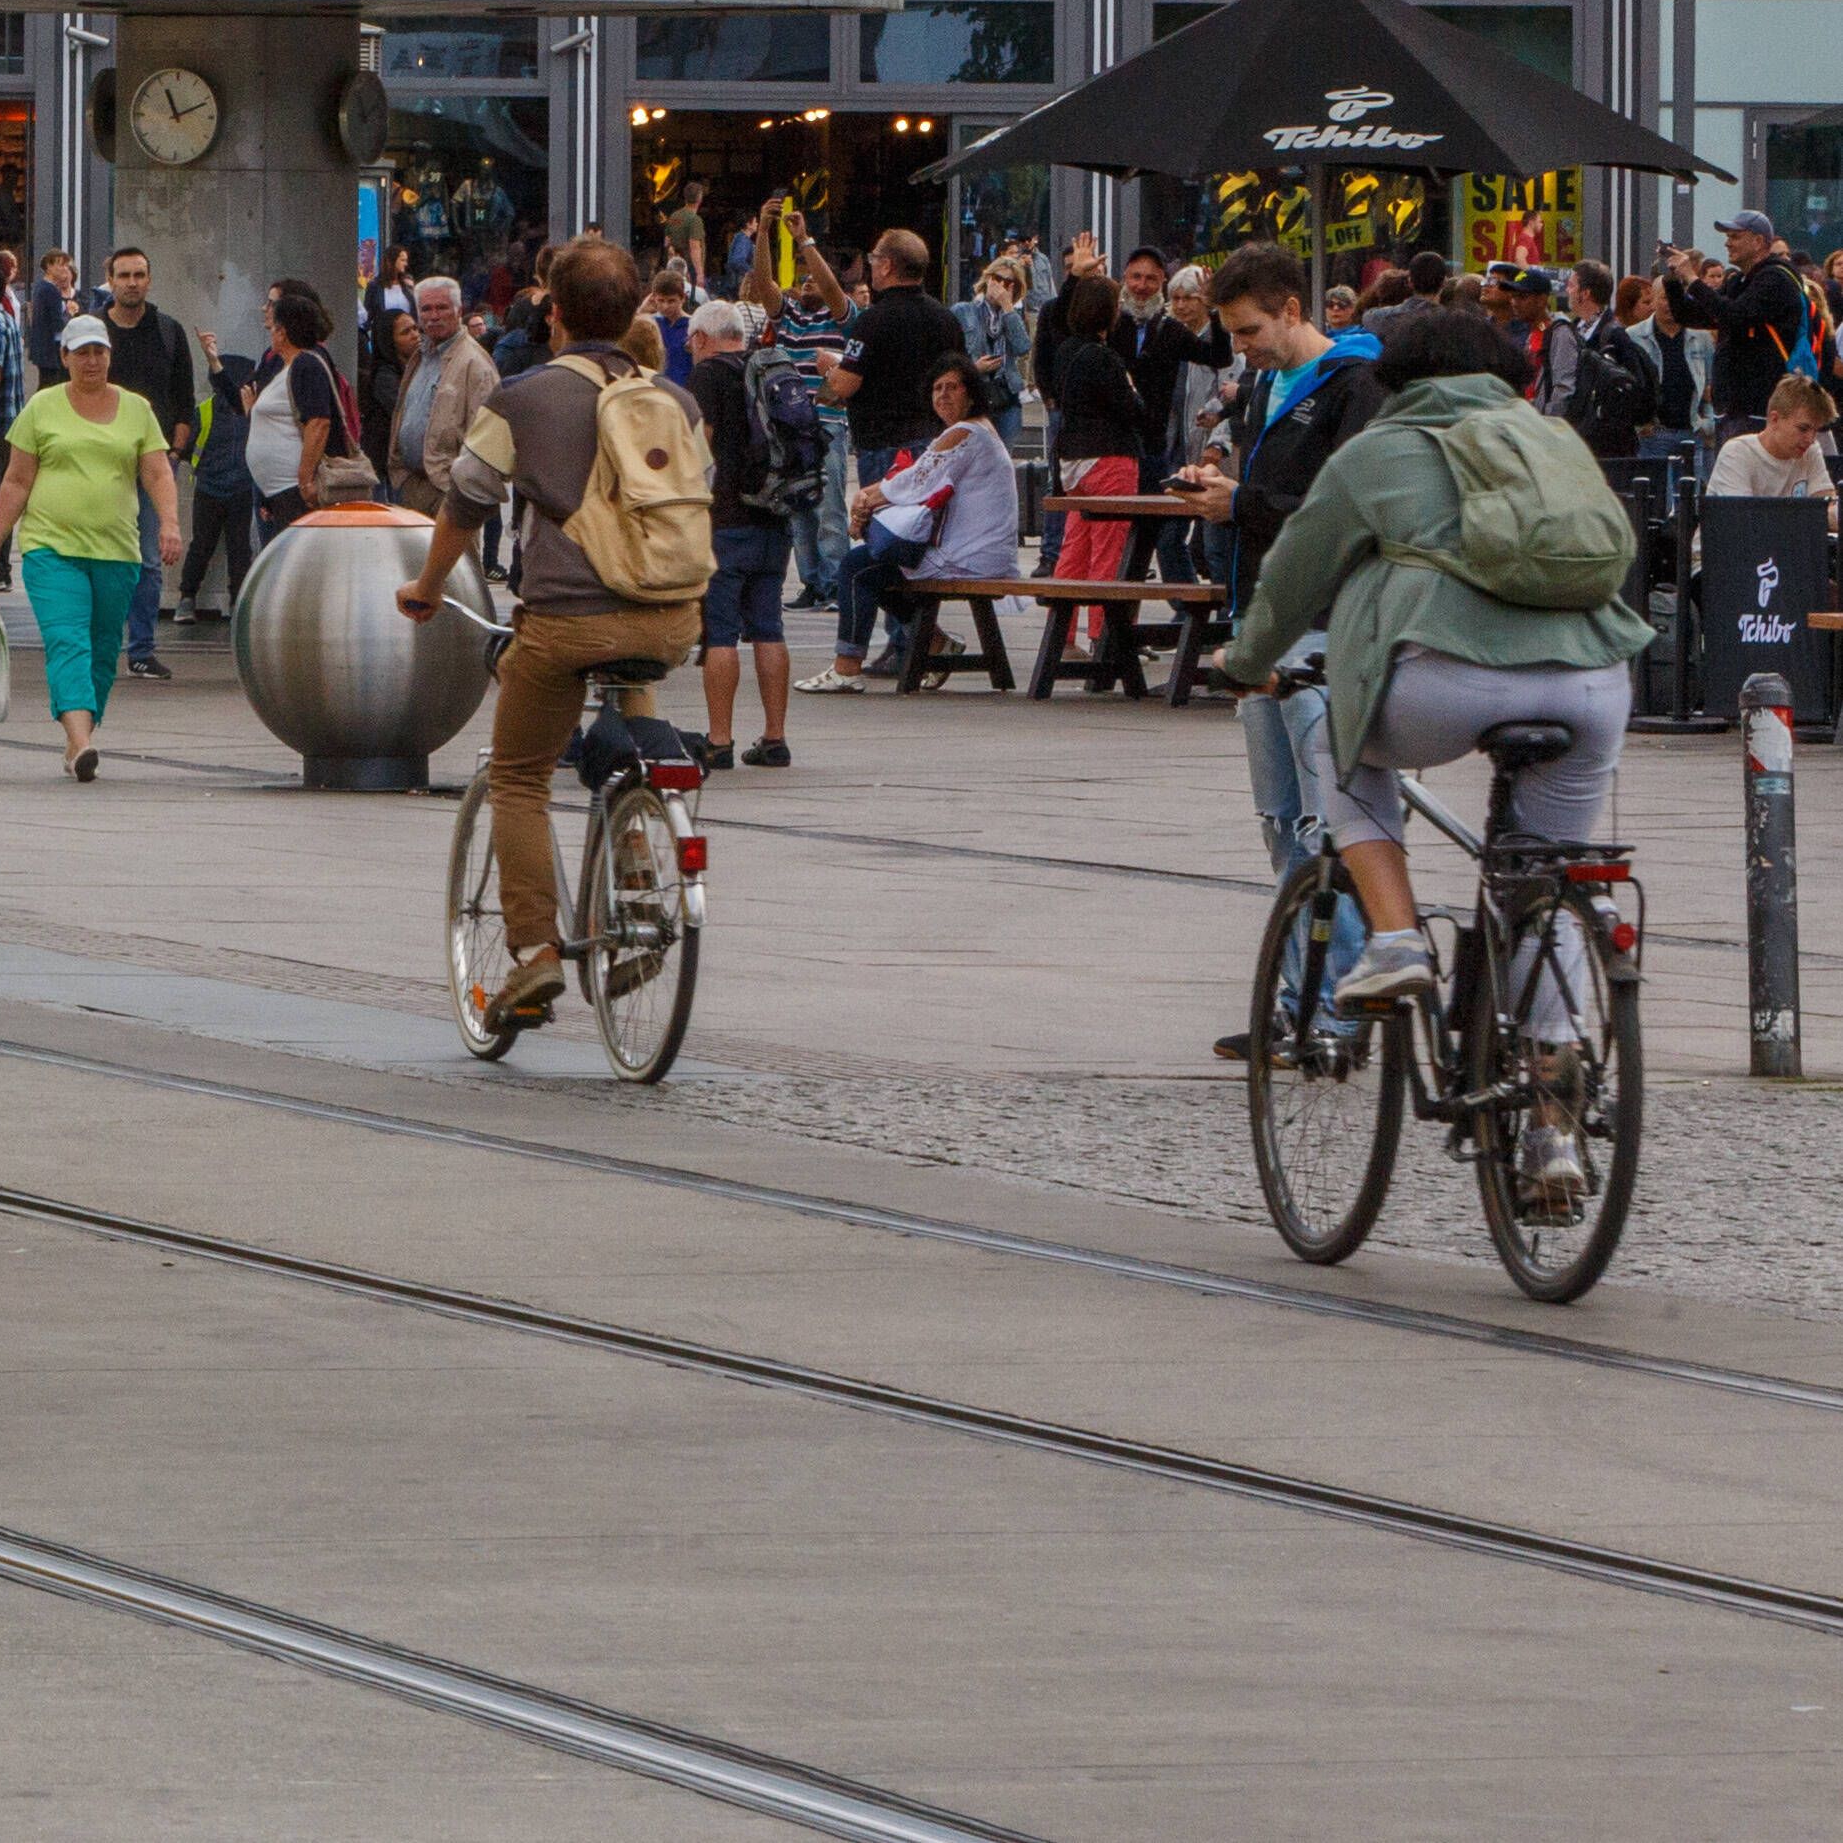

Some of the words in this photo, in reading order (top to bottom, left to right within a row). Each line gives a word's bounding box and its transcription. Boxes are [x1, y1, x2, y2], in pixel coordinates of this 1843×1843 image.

[1263, 125, 1445, 150] Tchibo
[1471, 169, 1576, 212] SALE
[1335, 225, 1363, 245] OFF
[1738, 615, 1796, 643] Tchibo
